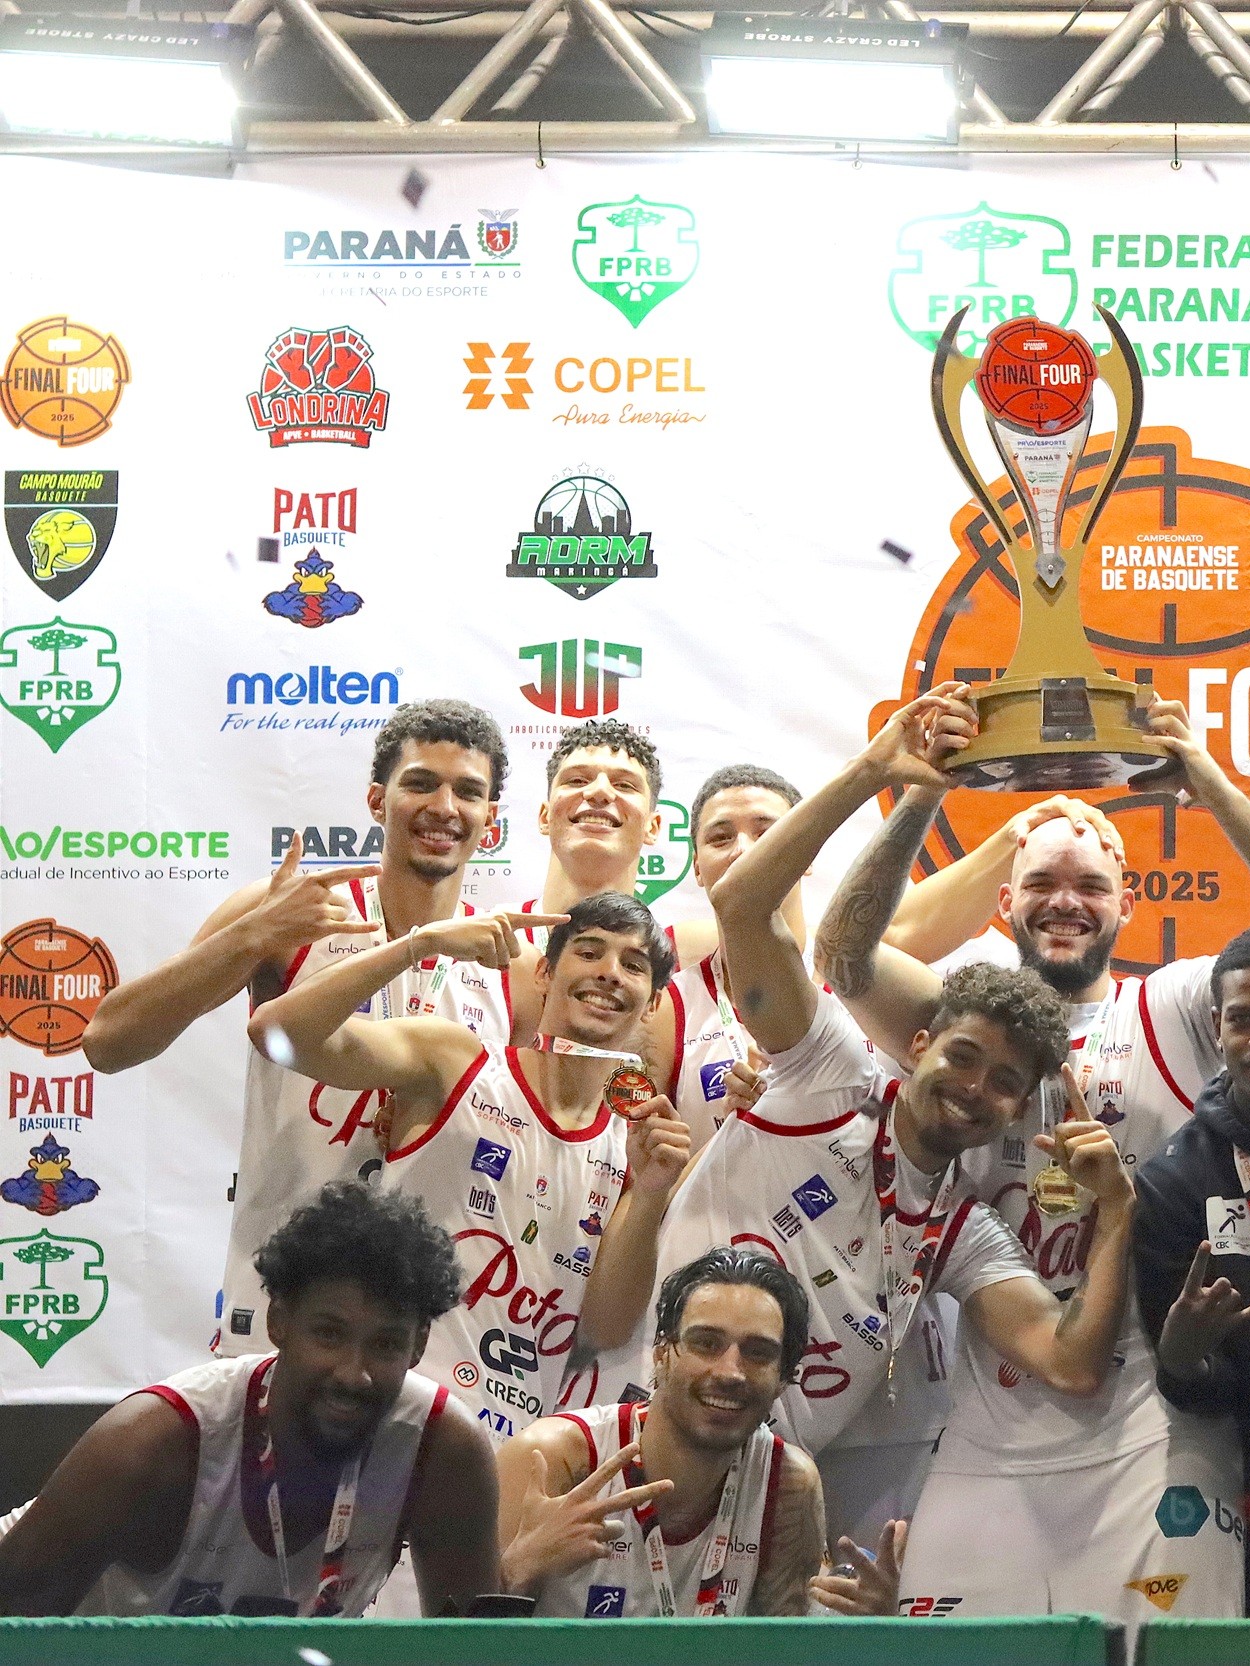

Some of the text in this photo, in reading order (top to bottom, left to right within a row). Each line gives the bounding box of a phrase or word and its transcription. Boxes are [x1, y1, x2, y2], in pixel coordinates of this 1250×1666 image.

[744, 32, 920, 48] LED CRAZY STROBE
[284, 223, 471, 260] PARANÁ
[400, 270, 522, 279] DO ESTADO
[599, 257, 673, 277] FPRB
[318, 286, 489, 298] ECRETARIA DO ESPORTE
[928, 295, 1036, 323] FPRB
[13, 366, 115, 396] FINAL FOUR
[554, 357, 706, 393] COPEL
[993, 364, 1081, 386] FINAL FOUR
[50, 412, 75, 422] 2025
[247, 391, 390, 431] LONDRINA
[552, 404, 707, 431] Pura Energia
[1029, 402, 1049, 411] 2025
[19, 470, 104, 490] CAMPO MOURÃO
[35, 490, 87, 502] BASQUETE
[273, 487, 358, 535] PATO
[283, 531, 346, 547] BASQUETE
[518, 535, 648, 565] ADRM
[1136, 534, 1204, 543] CAMPEONATO
[1101, 545, 1239, 568] PARANAENSE
[536, 564, 630, 577] MARINGÁ
[1101, 569, 1239, 592] DE BASQUETE
[19, 680, 94, 701] FPRB
[226, 664, 398, 705] molten
[220, 712, 387, 737] For the real gam
[271, 826, 384, 858] PARA
[1, 867, 230, 882] adual de Incentivo ao Esporte
[1121, 870, 1221, 902] 2025
[0, 974, 101, 1001] FINAL FOUR
[462, 1002, 484, 1023] PATO
[37, 1021, 61, 1030] 2025
[9, 1071, 95, 1120] PATO
[633, 1090, 652, 1101] FOUR
[1098, 1081, 1123, 1098] PATO
[471, 1092, 530, 1131] Limber
[19, 1117, 83, 1133] BASQUETE
[477, 1111, 522, 1137] SOFTWARE
[828, 1139, 860, 1180] Limbe
[468, 1184, 497, 1214] bets
[553, 1252, 592, 1278] BASS
[5, 1293, 81, 1316] FPRB
[842, 1312, 884, 1352] BASSO
